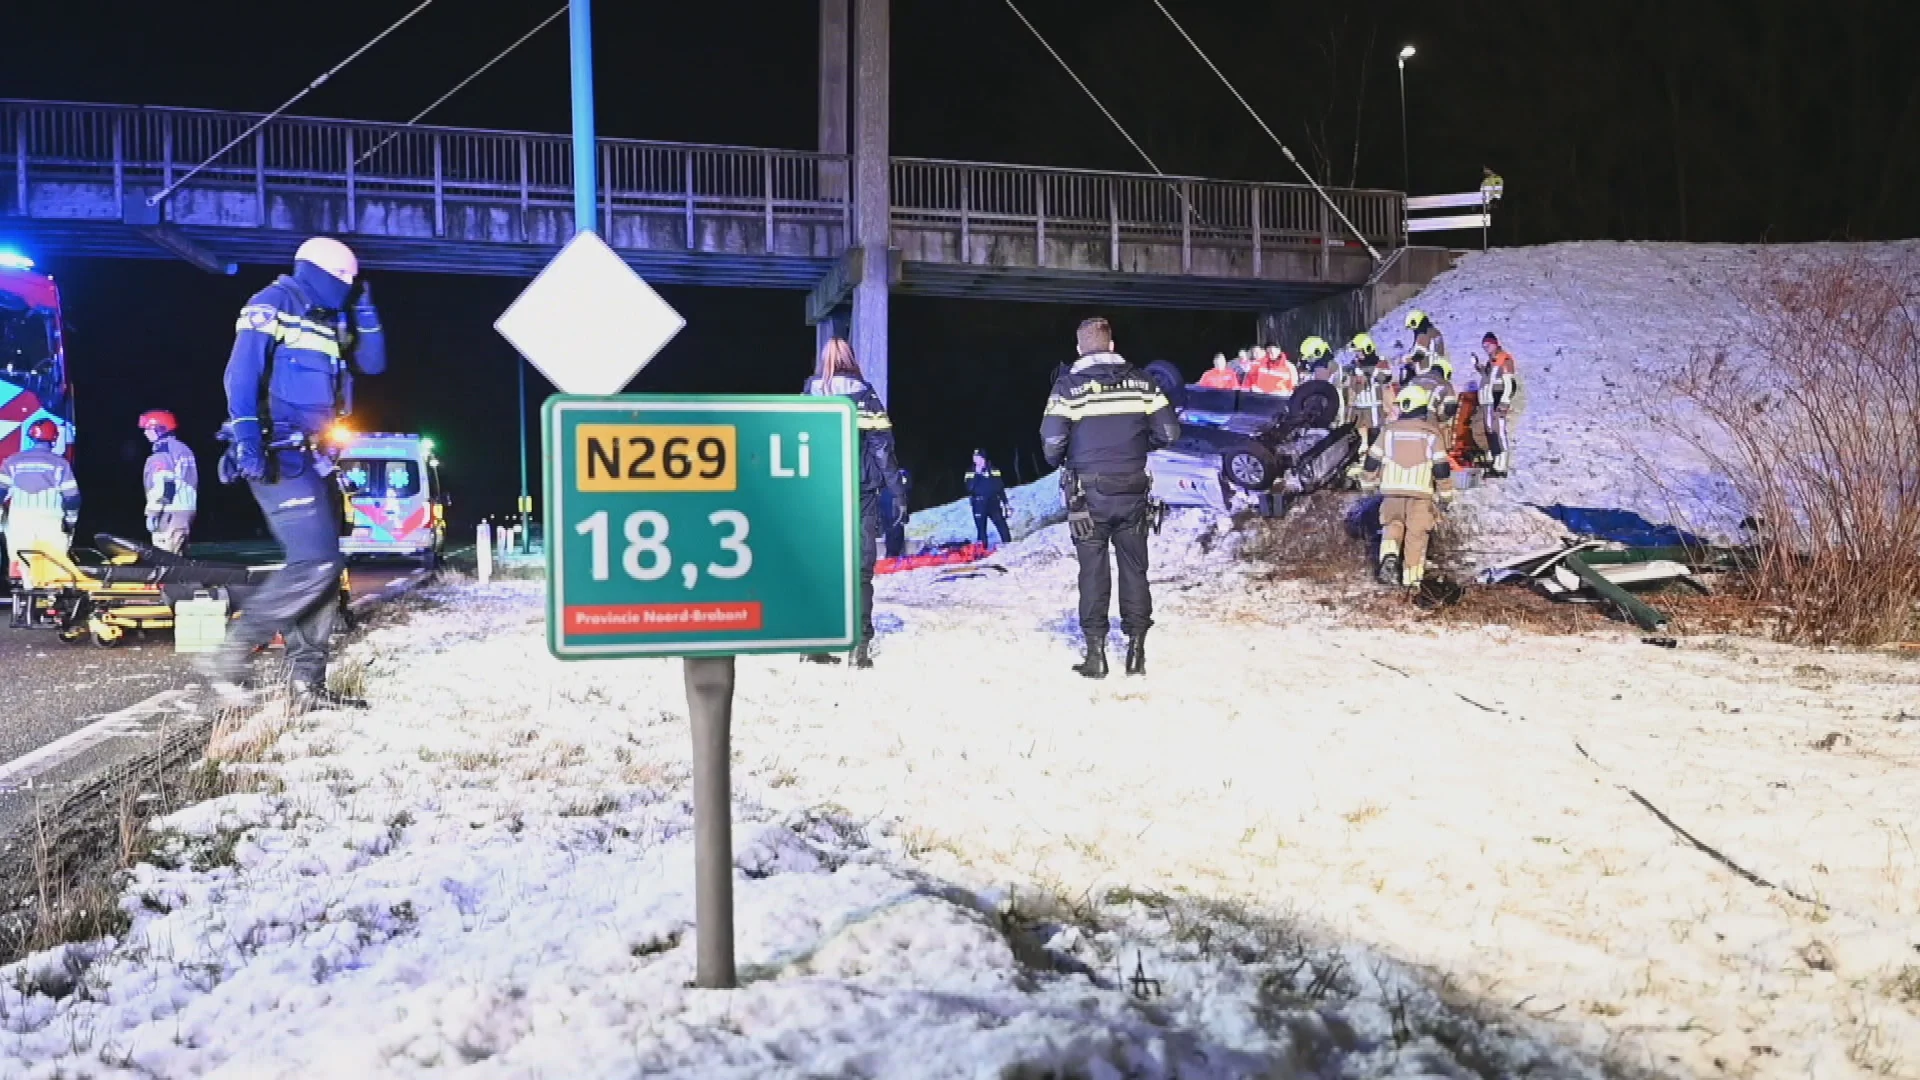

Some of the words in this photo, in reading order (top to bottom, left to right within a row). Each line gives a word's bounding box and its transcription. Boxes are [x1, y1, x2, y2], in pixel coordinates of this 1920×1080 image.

[586, 436, 727, 480] N269
[769, 431, 811, 478] Li
[574, 509, 753, 591] 18,3
[575, 611, 641, 625] Provincie
[643, 607, 749, 624] Noord-Brabant
